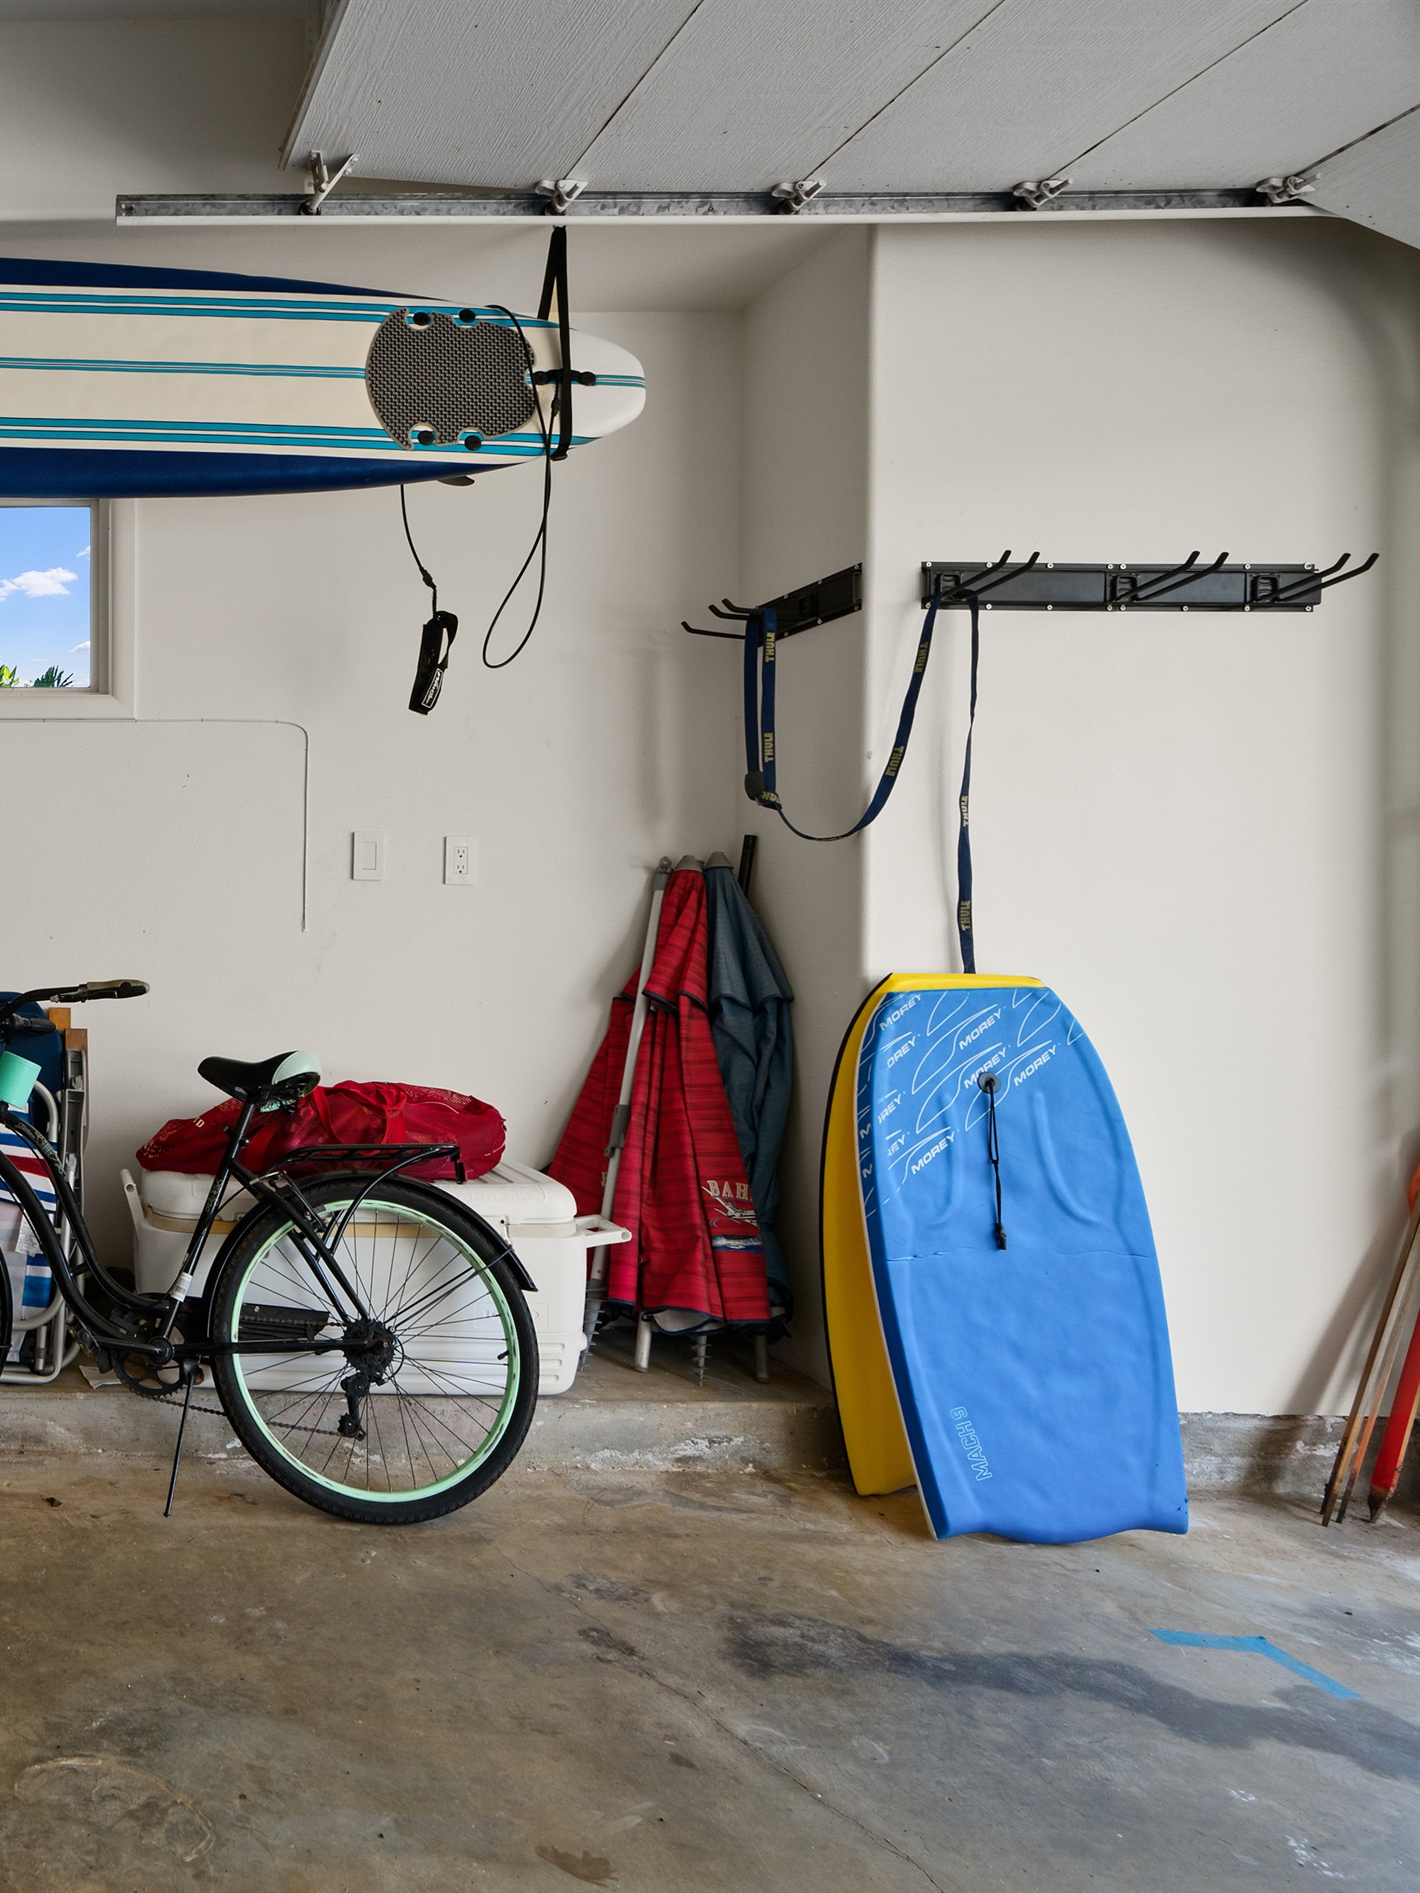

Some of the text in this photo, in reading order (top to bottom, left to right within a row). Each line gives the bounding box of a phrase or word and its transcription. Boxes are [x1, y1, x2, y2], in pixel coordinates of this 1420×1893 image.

[879, 994, 922, 1031] MOREY
[958, 1008, 1002, 1050] MOREY
[1013, 1044, 1057, 1087] MOREY
[910, 1130, 956, 1175] MOREY
[949, 1405, 993, 1482] MACH 9
